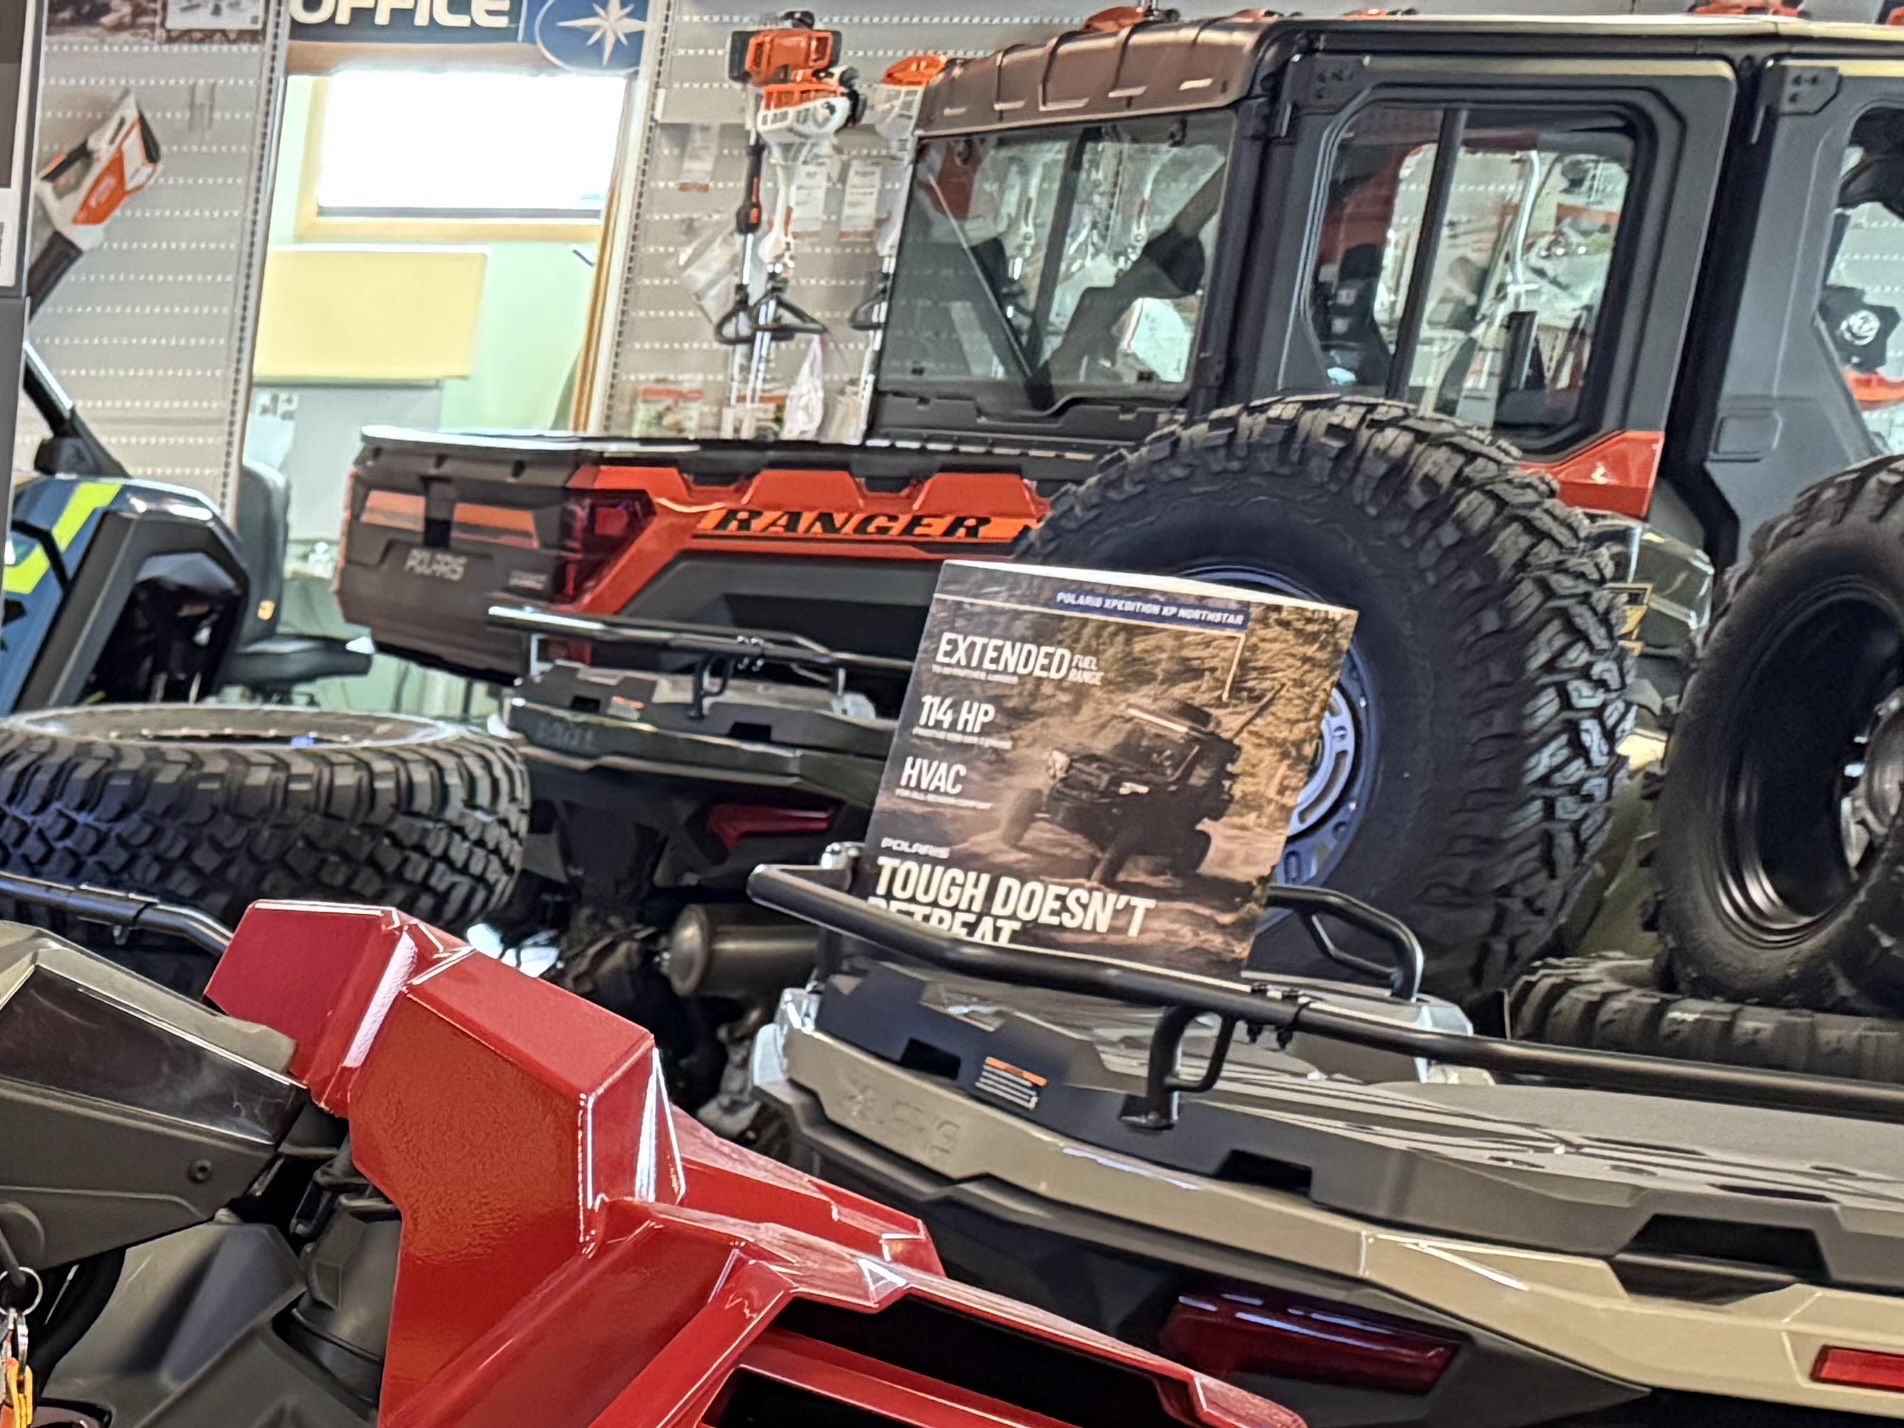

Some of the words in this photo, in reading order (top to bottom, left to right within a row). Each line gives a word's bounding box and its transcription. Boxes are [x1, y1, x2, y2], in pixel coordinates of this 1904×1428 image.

[711, 507, 992, 539] RANGER
[1178, 606, 1245, 625] NORTHSTAR
[935, 631, 1072, 680] EXTENDED
[1071, 654, 1098, 671] FUEL
[1068, 668, 1104, 686] RANGE
[918, 694, 954, 730] 114
[956, 699, 996, 734] HP
[899, 755, 968, 795] HVAC
[880, 837, 950, 859] POLARIS
[875, 856, 991, 913] TOUGH
[990, 876, 1157, 938] DOESN'T
